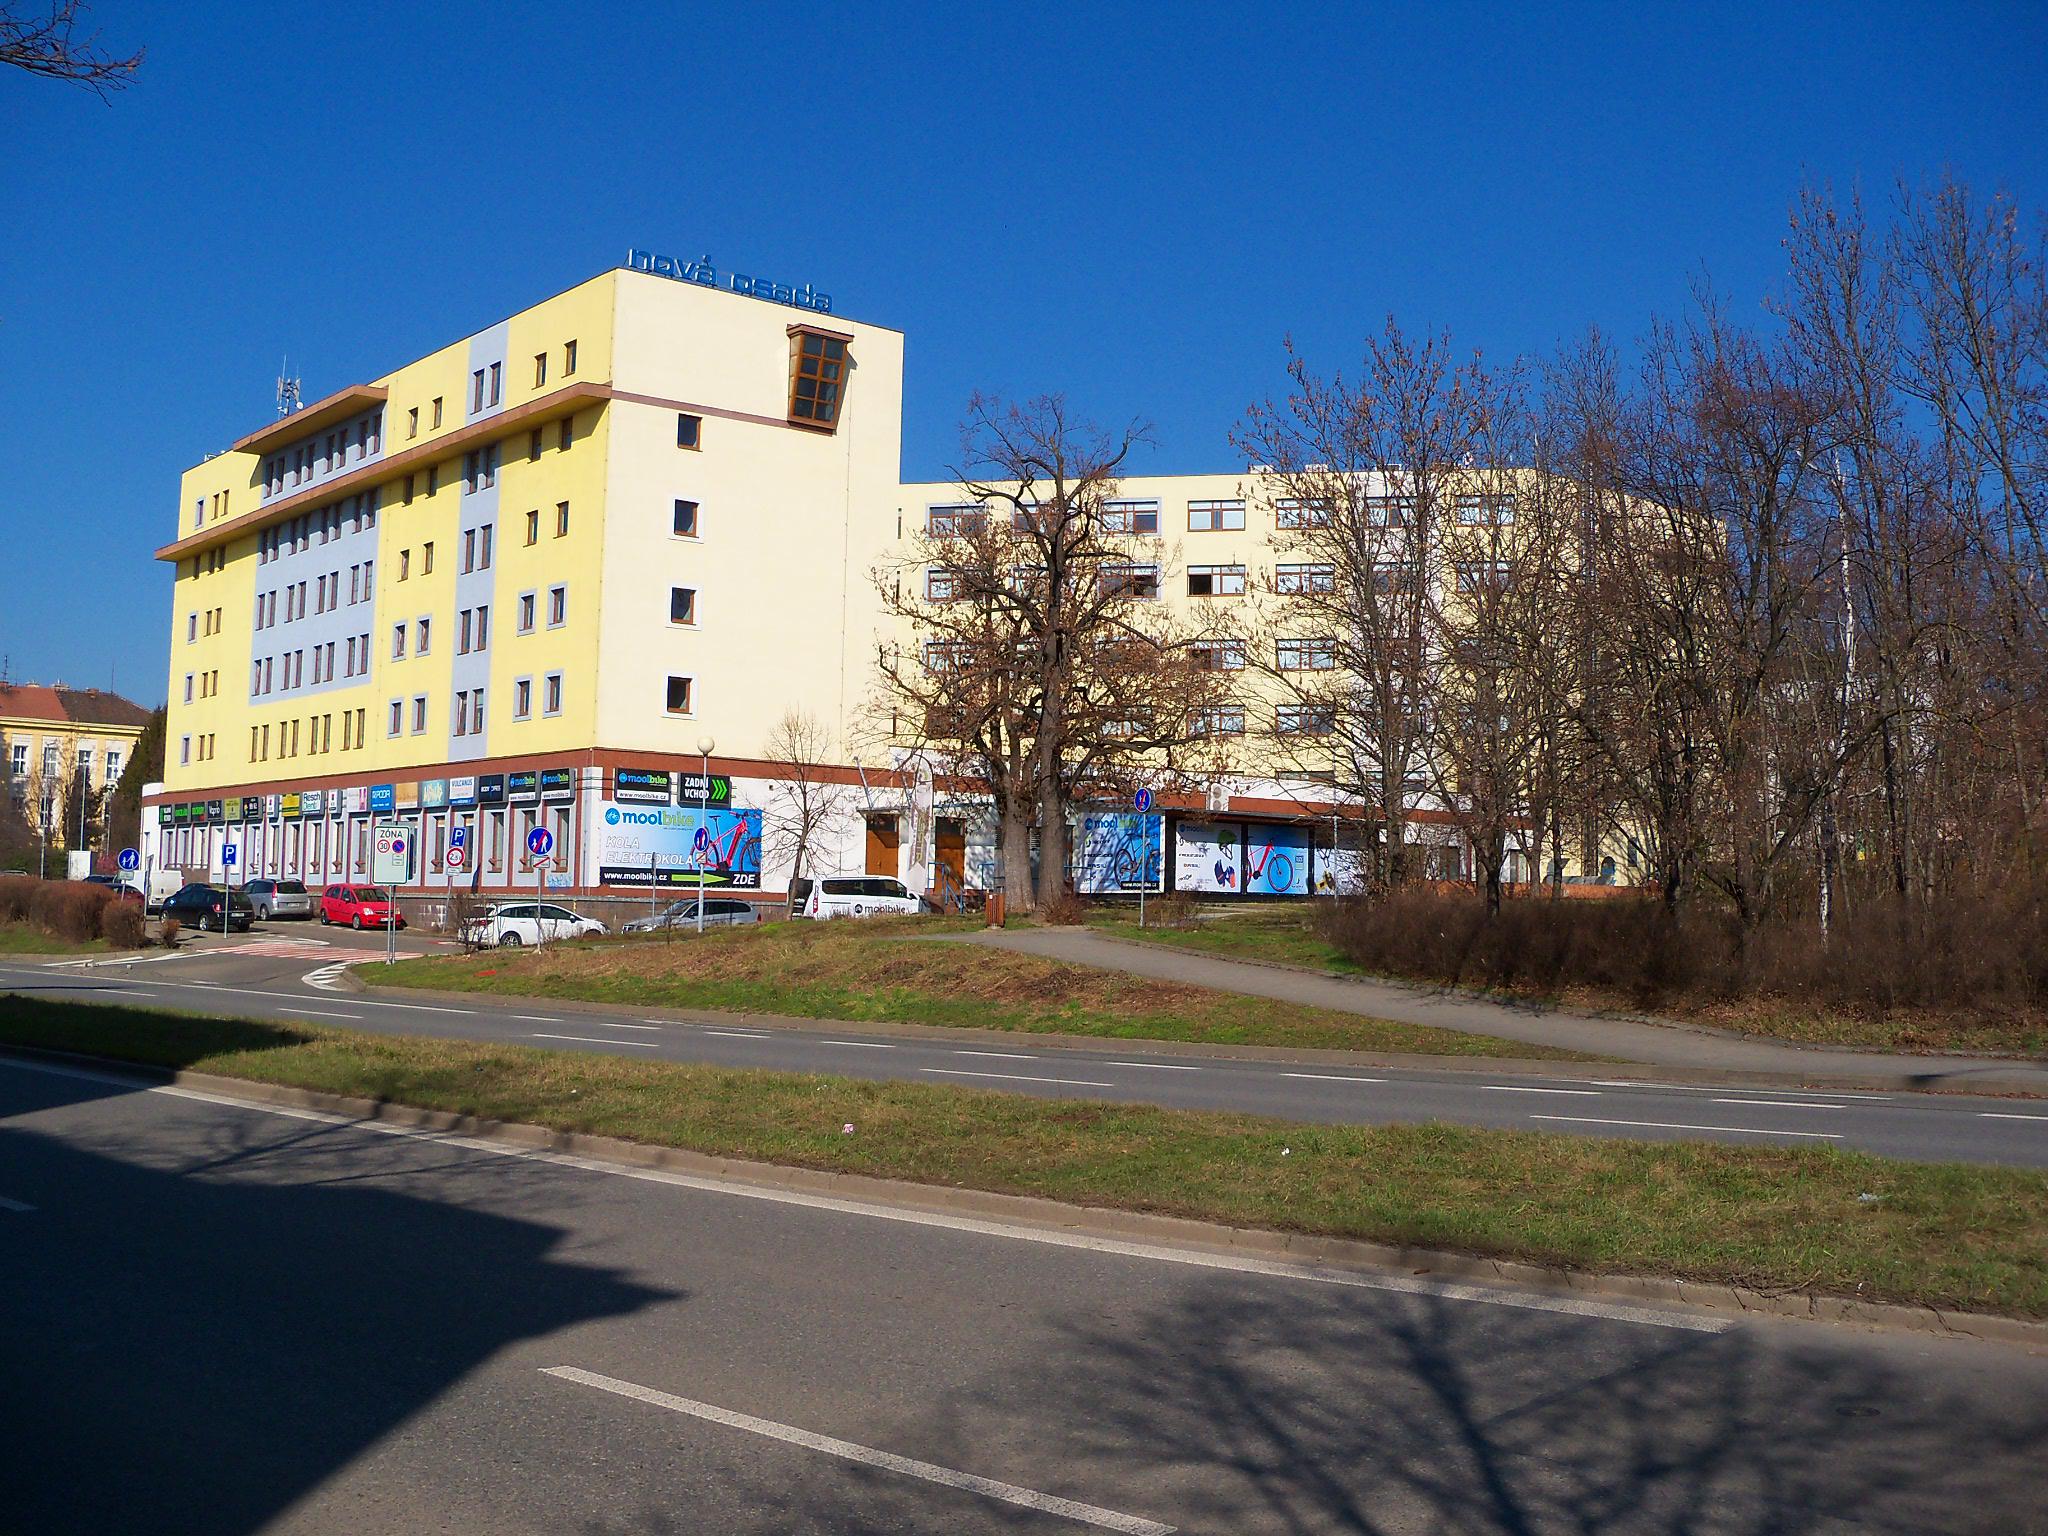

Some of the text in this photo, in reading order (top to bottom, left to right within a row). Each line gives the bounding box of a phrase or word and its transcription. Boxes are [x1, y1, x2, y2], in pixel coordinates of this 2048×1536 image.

[628, 248, 833, 313] nová osada
[628, 774, 668, 785] moolbike
[684, 776, 709, 788] ZADNÍ
[619, 791, 667, 800] www.moolbike.cz
[684, 788, 710, 799] VCHOD
[622, 811, 695, 826] moolbike
[380, 828, 403, 838] ZÓNA
[455, 829, 463, 840] P
[380, 842, 388, 850] 30
[606, 835, 640, 849] KOLA
[225, 846, 235, 859] P
[606, 851, 693, 866] ELEKTROKOLA
[603, 872, 668, 881] www.moolbik.cz
[732, 873, 756, 886] ZDE
[864, 904, 906, 914] moolbike
